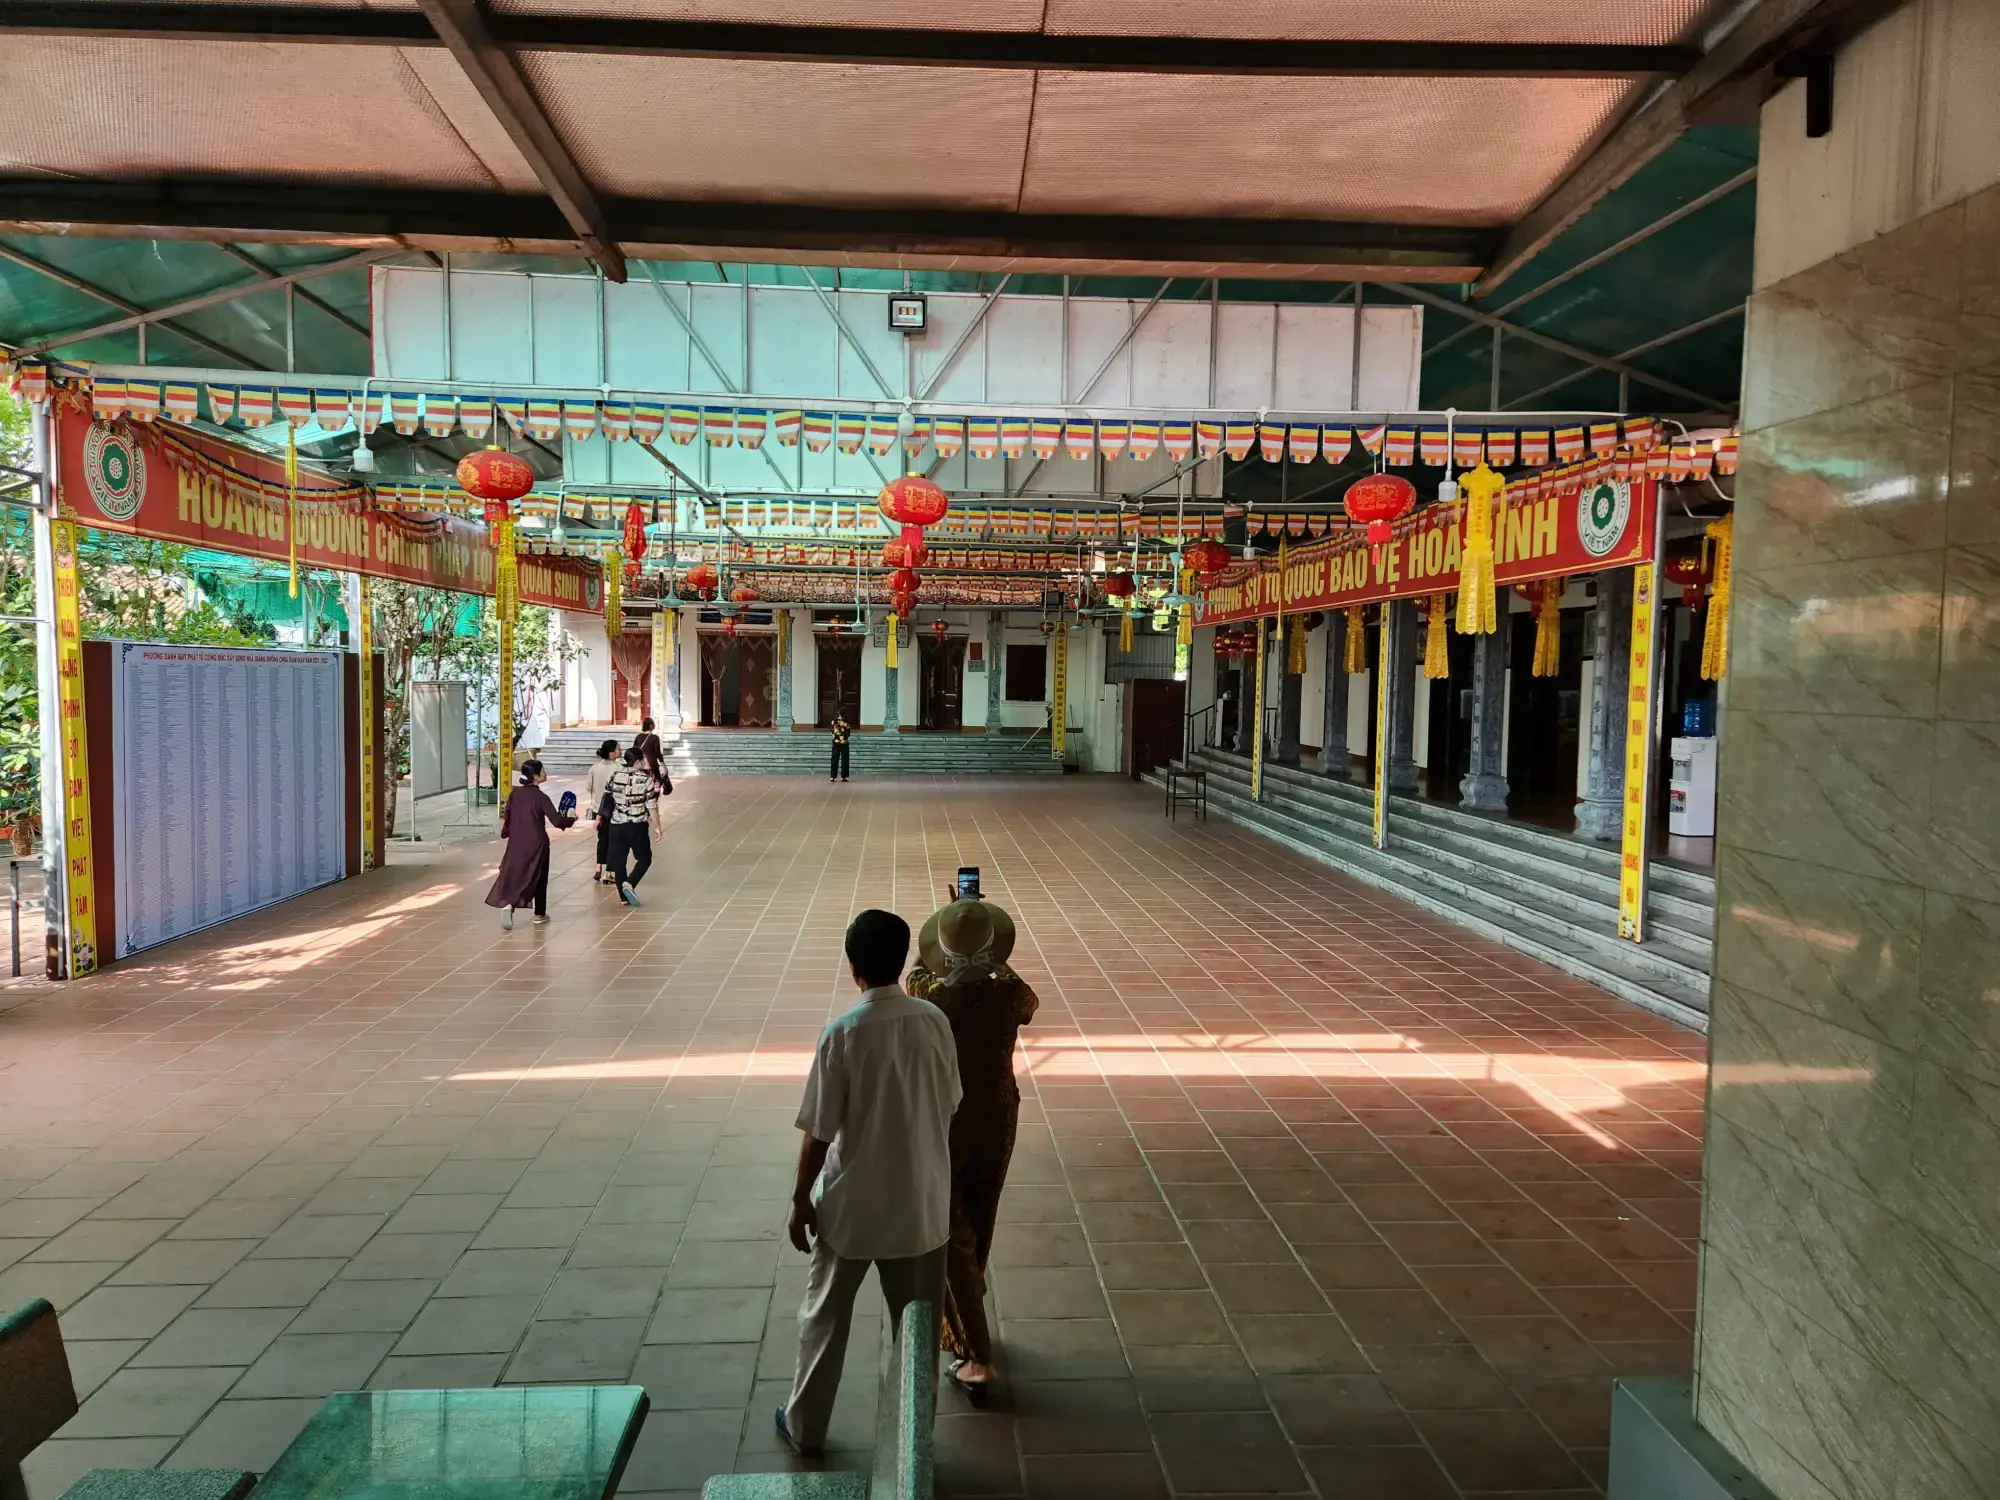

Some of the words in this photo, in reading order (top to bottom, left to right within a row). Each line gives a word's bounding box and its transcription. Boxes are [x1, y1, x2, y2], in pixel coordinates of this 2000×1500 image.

[117, 493, 137, 511] NAM
[1602, 525, 1620, 548] NAM
[554, 571, 579, 601] SINH
